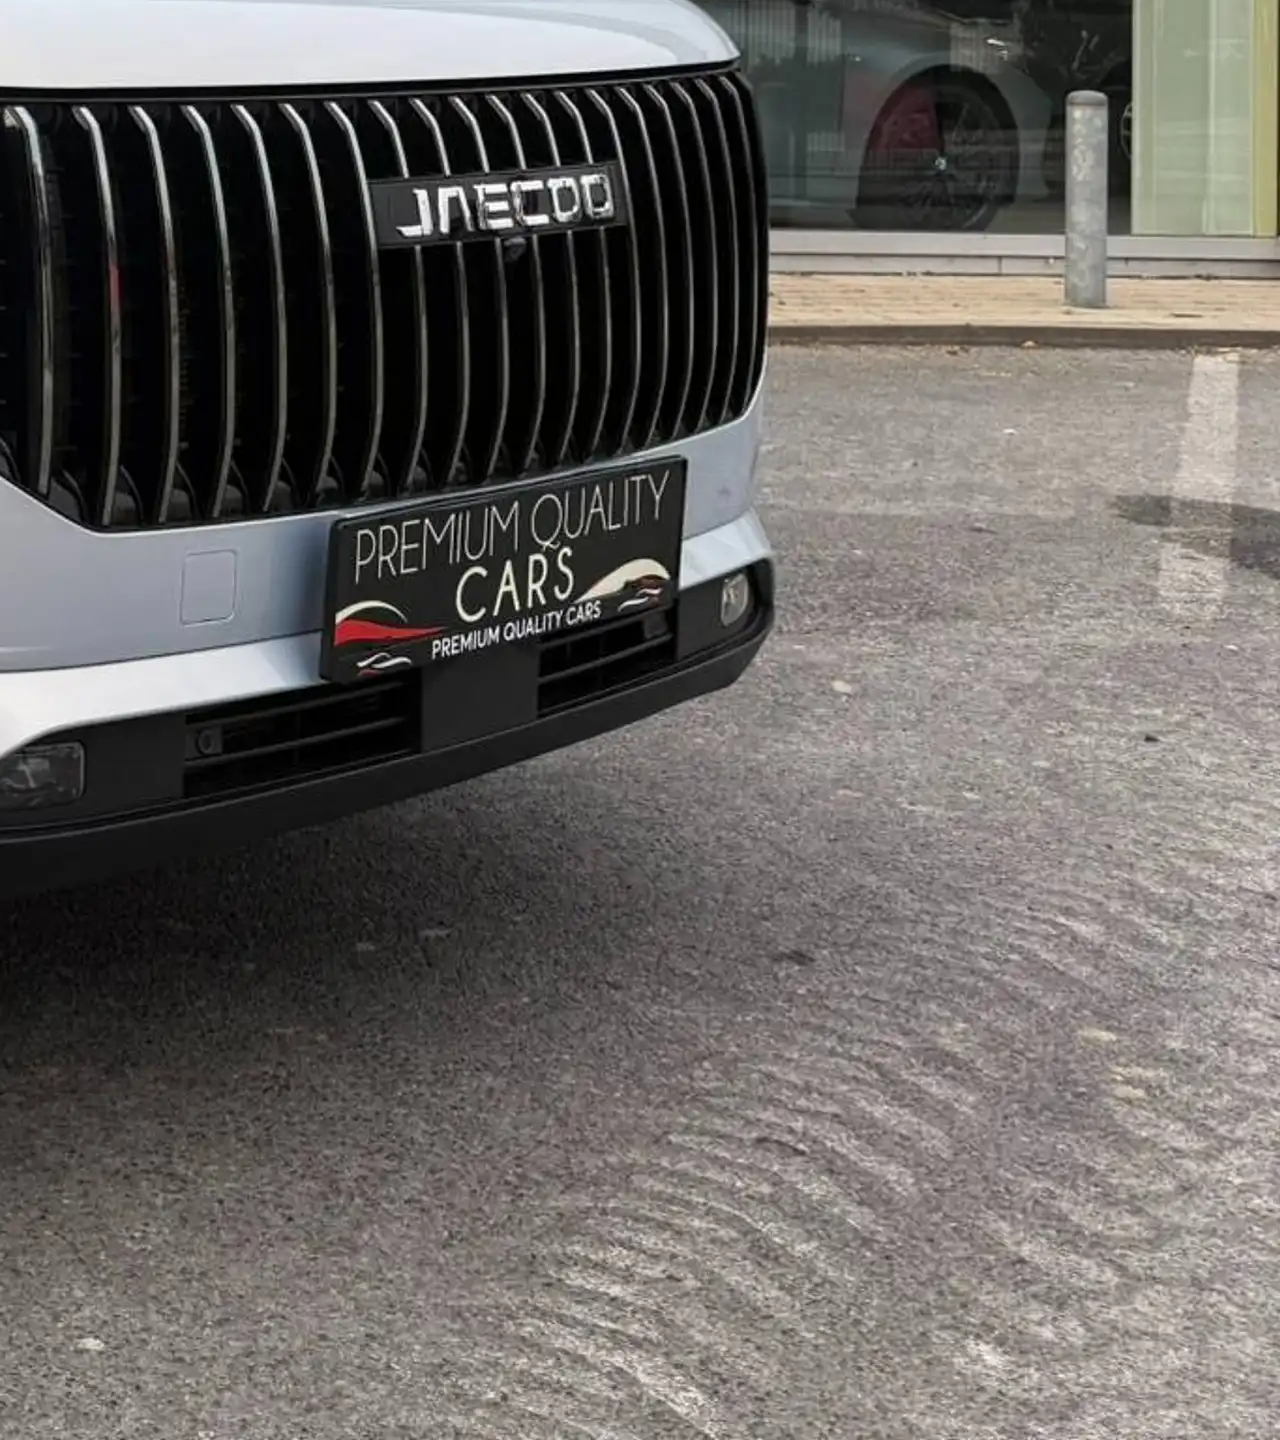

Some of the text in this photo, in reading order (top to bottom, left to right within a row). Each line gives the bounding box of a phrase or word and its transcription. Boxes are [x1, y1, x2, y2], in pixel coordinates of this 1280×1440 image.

[396, 173, 614, 237] JAECOO
[354, 469, 670, 584] PREMIUM QUALITY
[456, 546, 575, 623] CARS
[432, 599, 602, 660] PREMIUM QUALITY CARS
